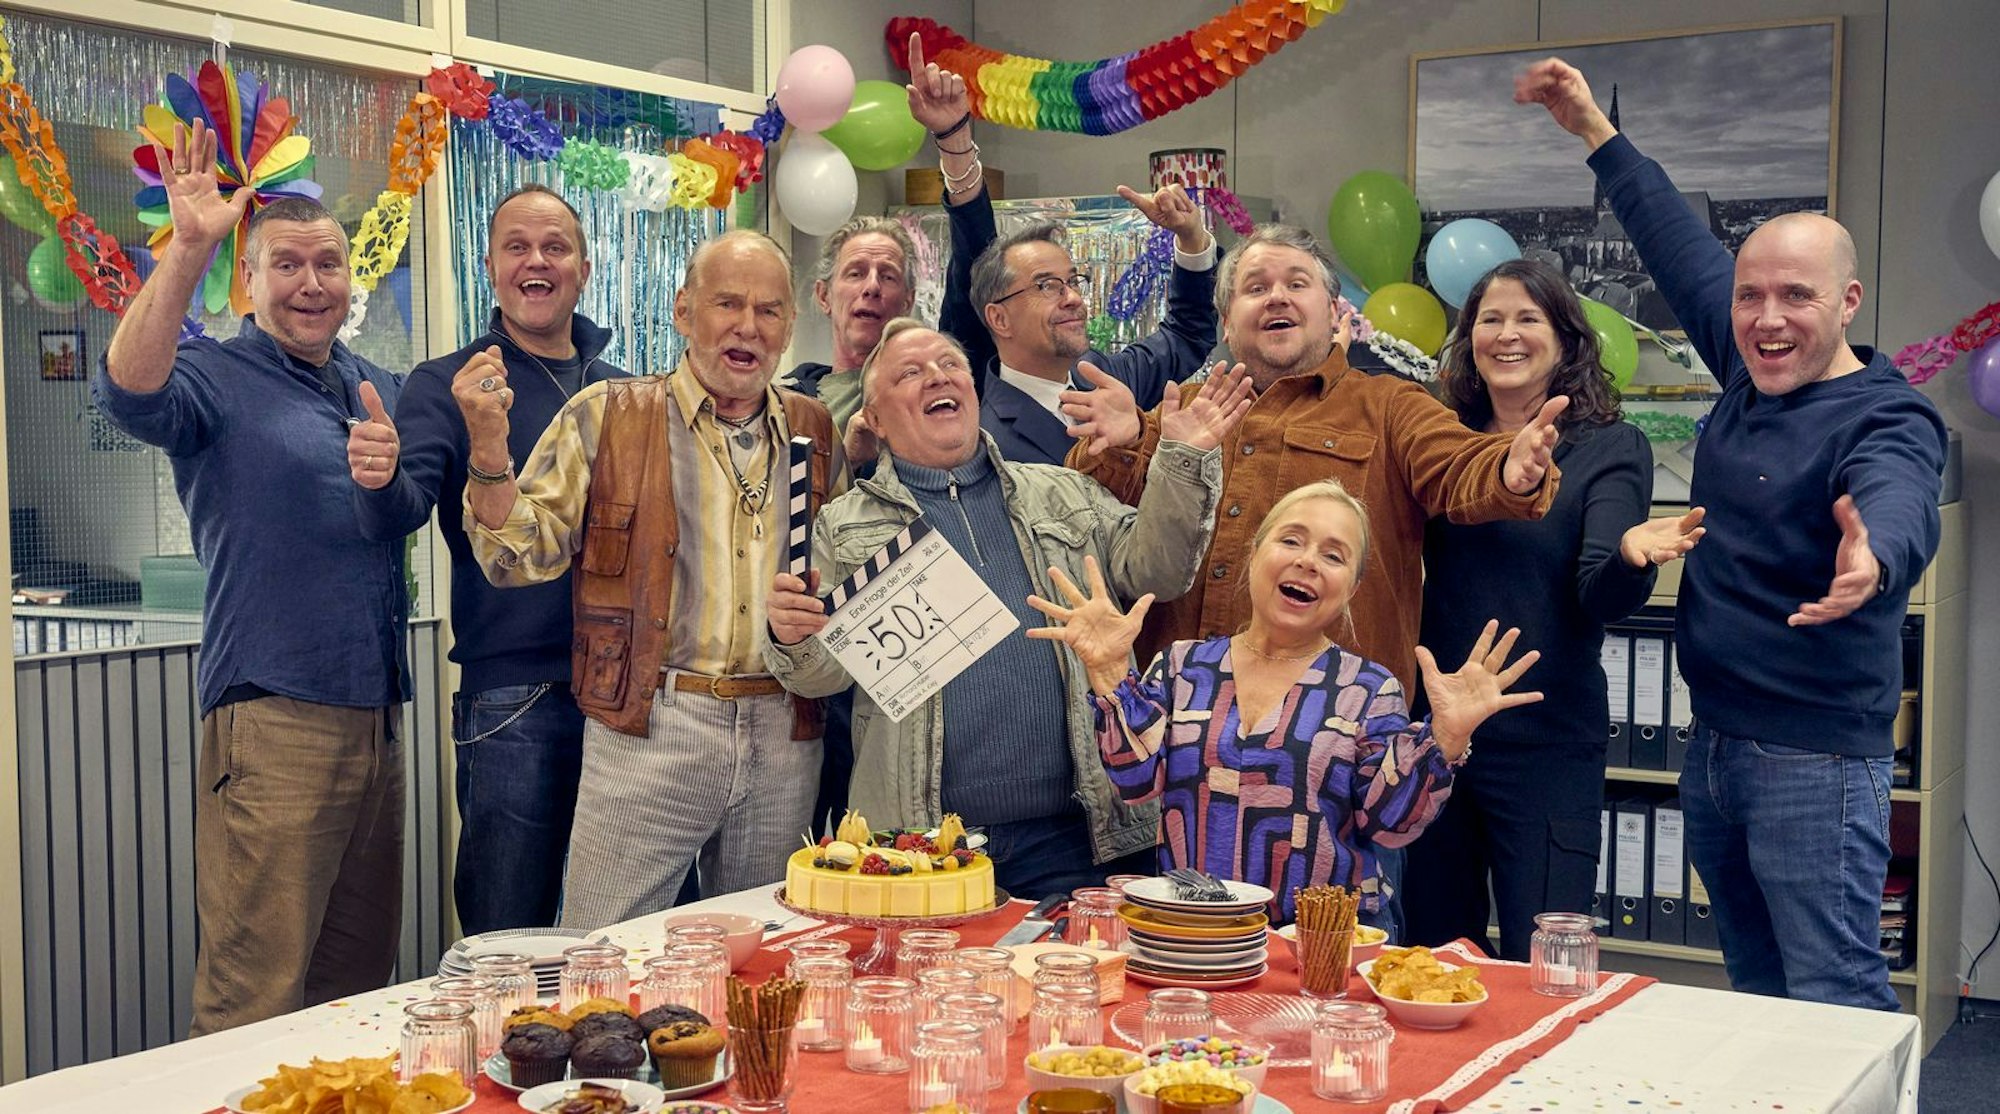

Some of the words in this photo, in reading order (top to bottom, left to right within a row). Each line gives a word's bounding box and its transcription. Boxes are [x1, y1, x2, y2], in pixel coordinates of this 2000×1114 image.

[912, 574, 928, 588] TAKE
[849, 602, 867, 619] Eine
[864, 586, 887, 606] Frage
[886, 575, 900, 588] der
[898, 563, 915, 579] Zeit
[834, 638, 852, 654] SCENE
[913, 660, 922, 670] B
[876, 691, 885, 701] A
[888, 698, 900, 709] DIR
[892, 705, 906, 718] CAM
